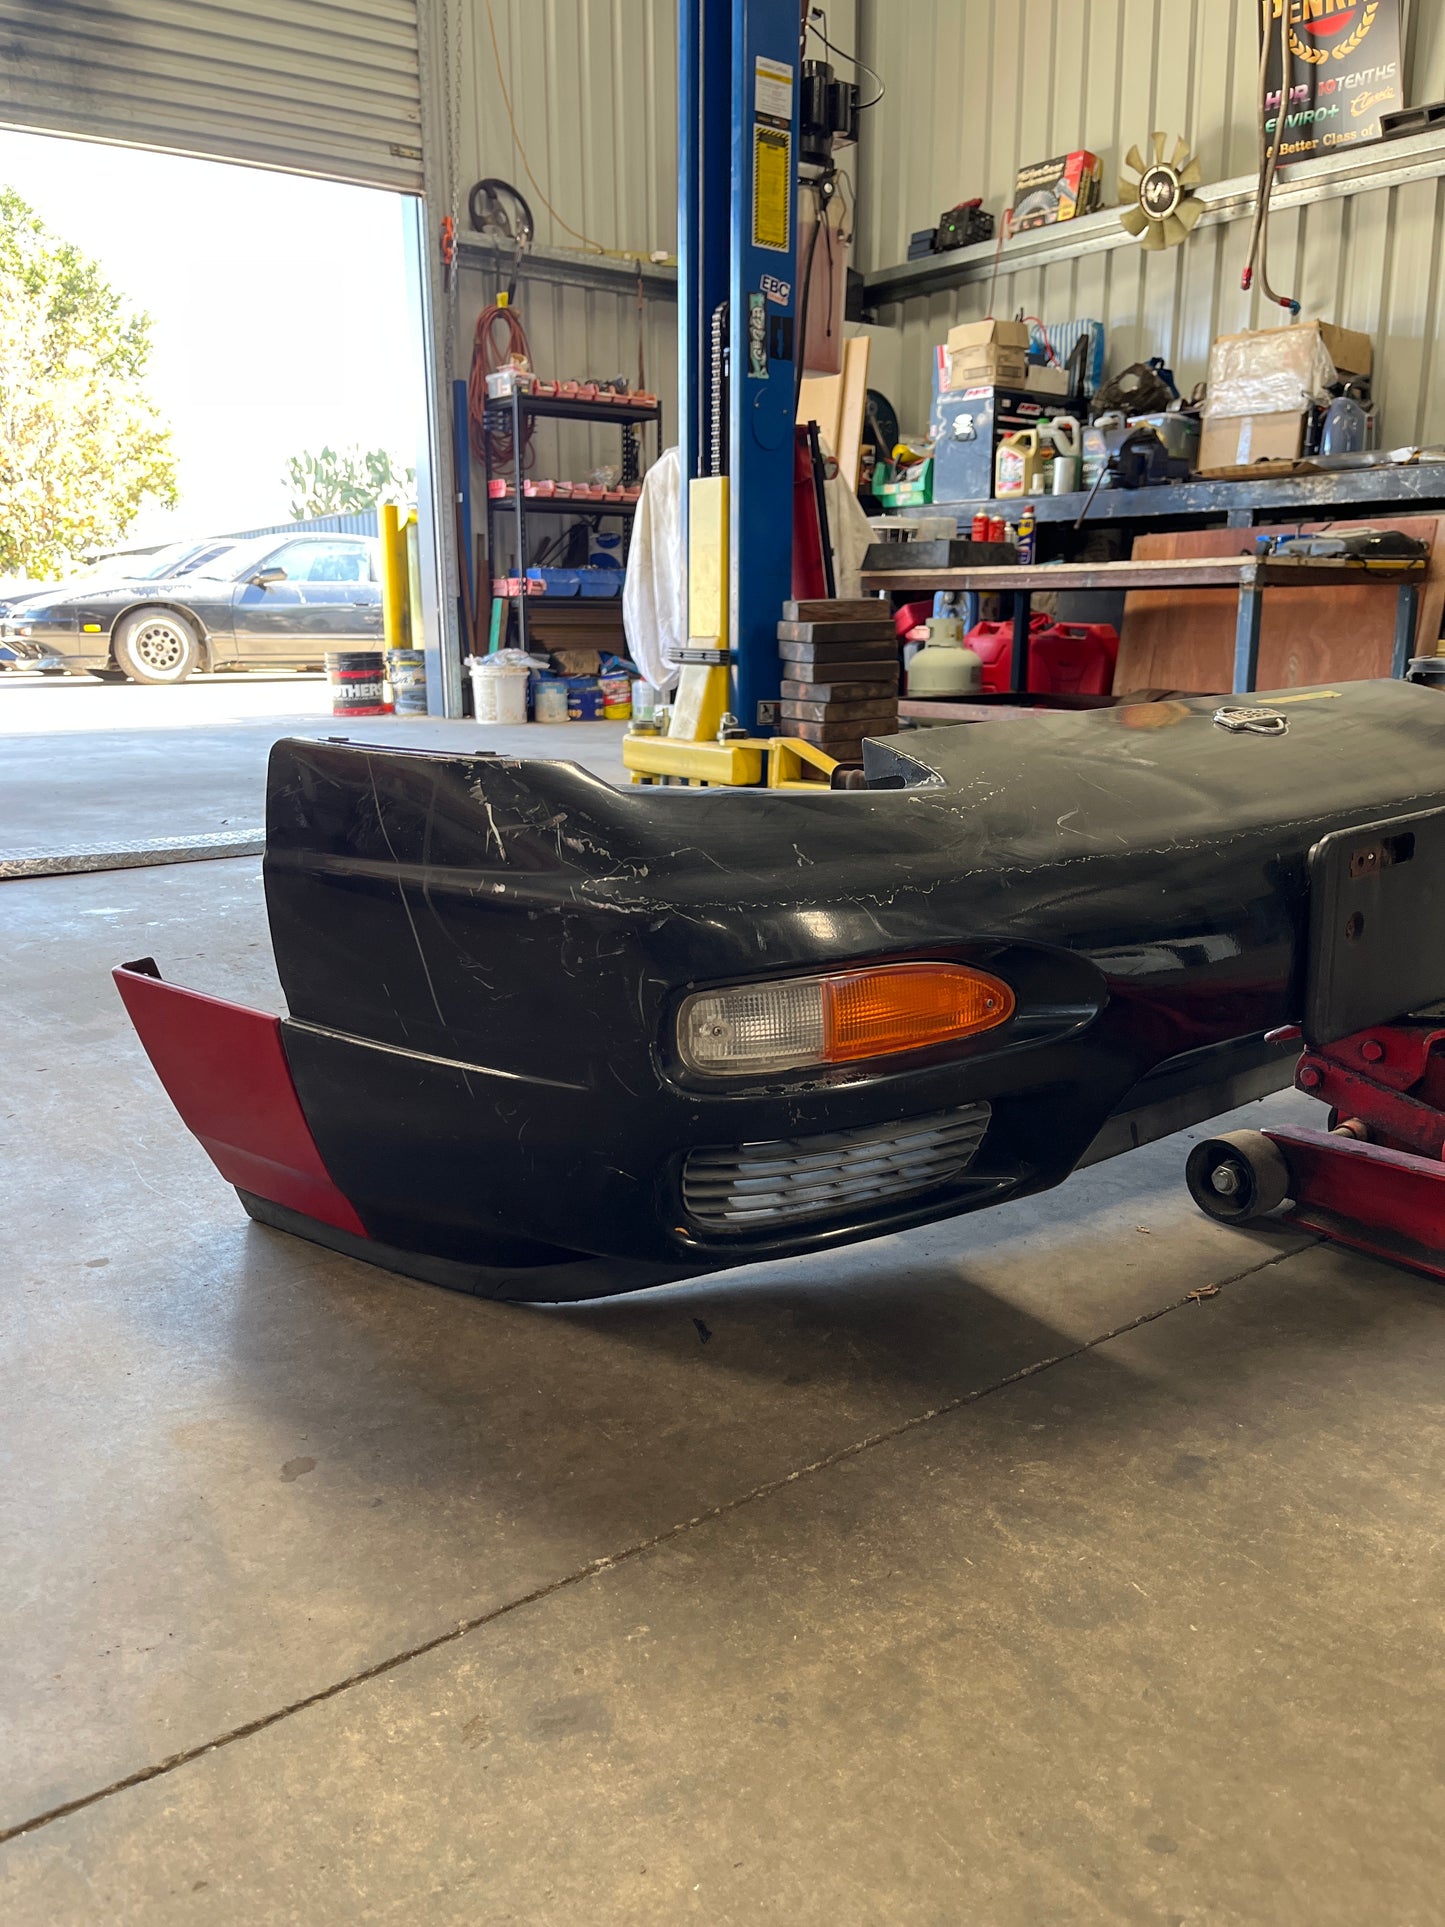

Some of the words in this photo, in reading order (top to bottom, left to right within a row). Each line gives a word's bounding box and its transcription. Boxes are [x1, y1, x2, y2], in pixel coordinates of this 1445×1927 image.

[1279, 138, 1320, 156] Better
[1323, 130, 1357, 146] Class
[1361, 123, 1375, 138] of
[762, 276, 789, 298] EBC
